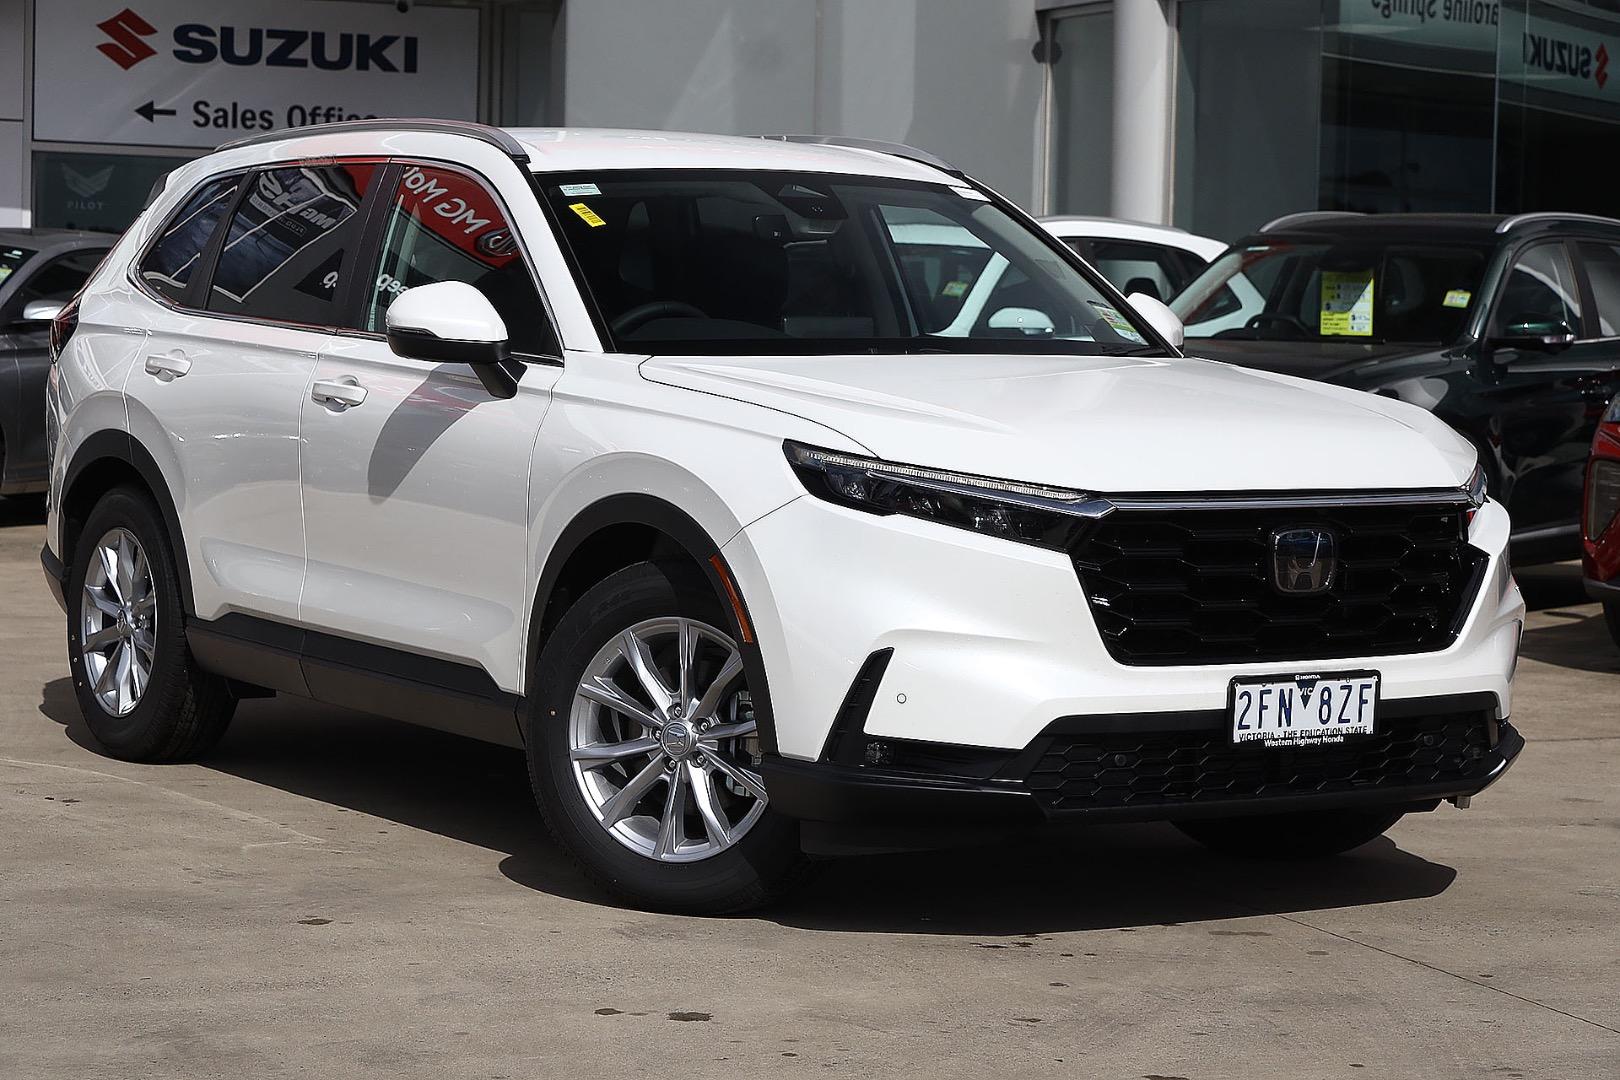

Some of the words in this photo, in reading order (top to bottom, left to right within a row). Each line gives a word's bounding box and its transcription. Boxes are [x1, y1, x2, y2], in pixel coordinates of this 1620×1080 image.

[173, 23, 418, 74] SUZUKI
[193, 100, 273, 130] Sales
[286, 104, 377, 128] Offi
[67, 199, 104, 211] PILOT
[1299, 687, 1314, 696] VIC
[1238, 688, 1293, 730] 2FN
[1318, 684, 1372, 725] 8ZF
[1238, 731, 1275, 742] VICTORIA
[1283, 730, 1298, 739] THE
[1300, 728, 1342, 737] EDUCATION
[1345, 725, 1368, 735] STATE
[1264, 738, 1292, 747] Western
[1293, 736, 1321, 746] Highway
[1322, 735, 1344, 744] Honda
